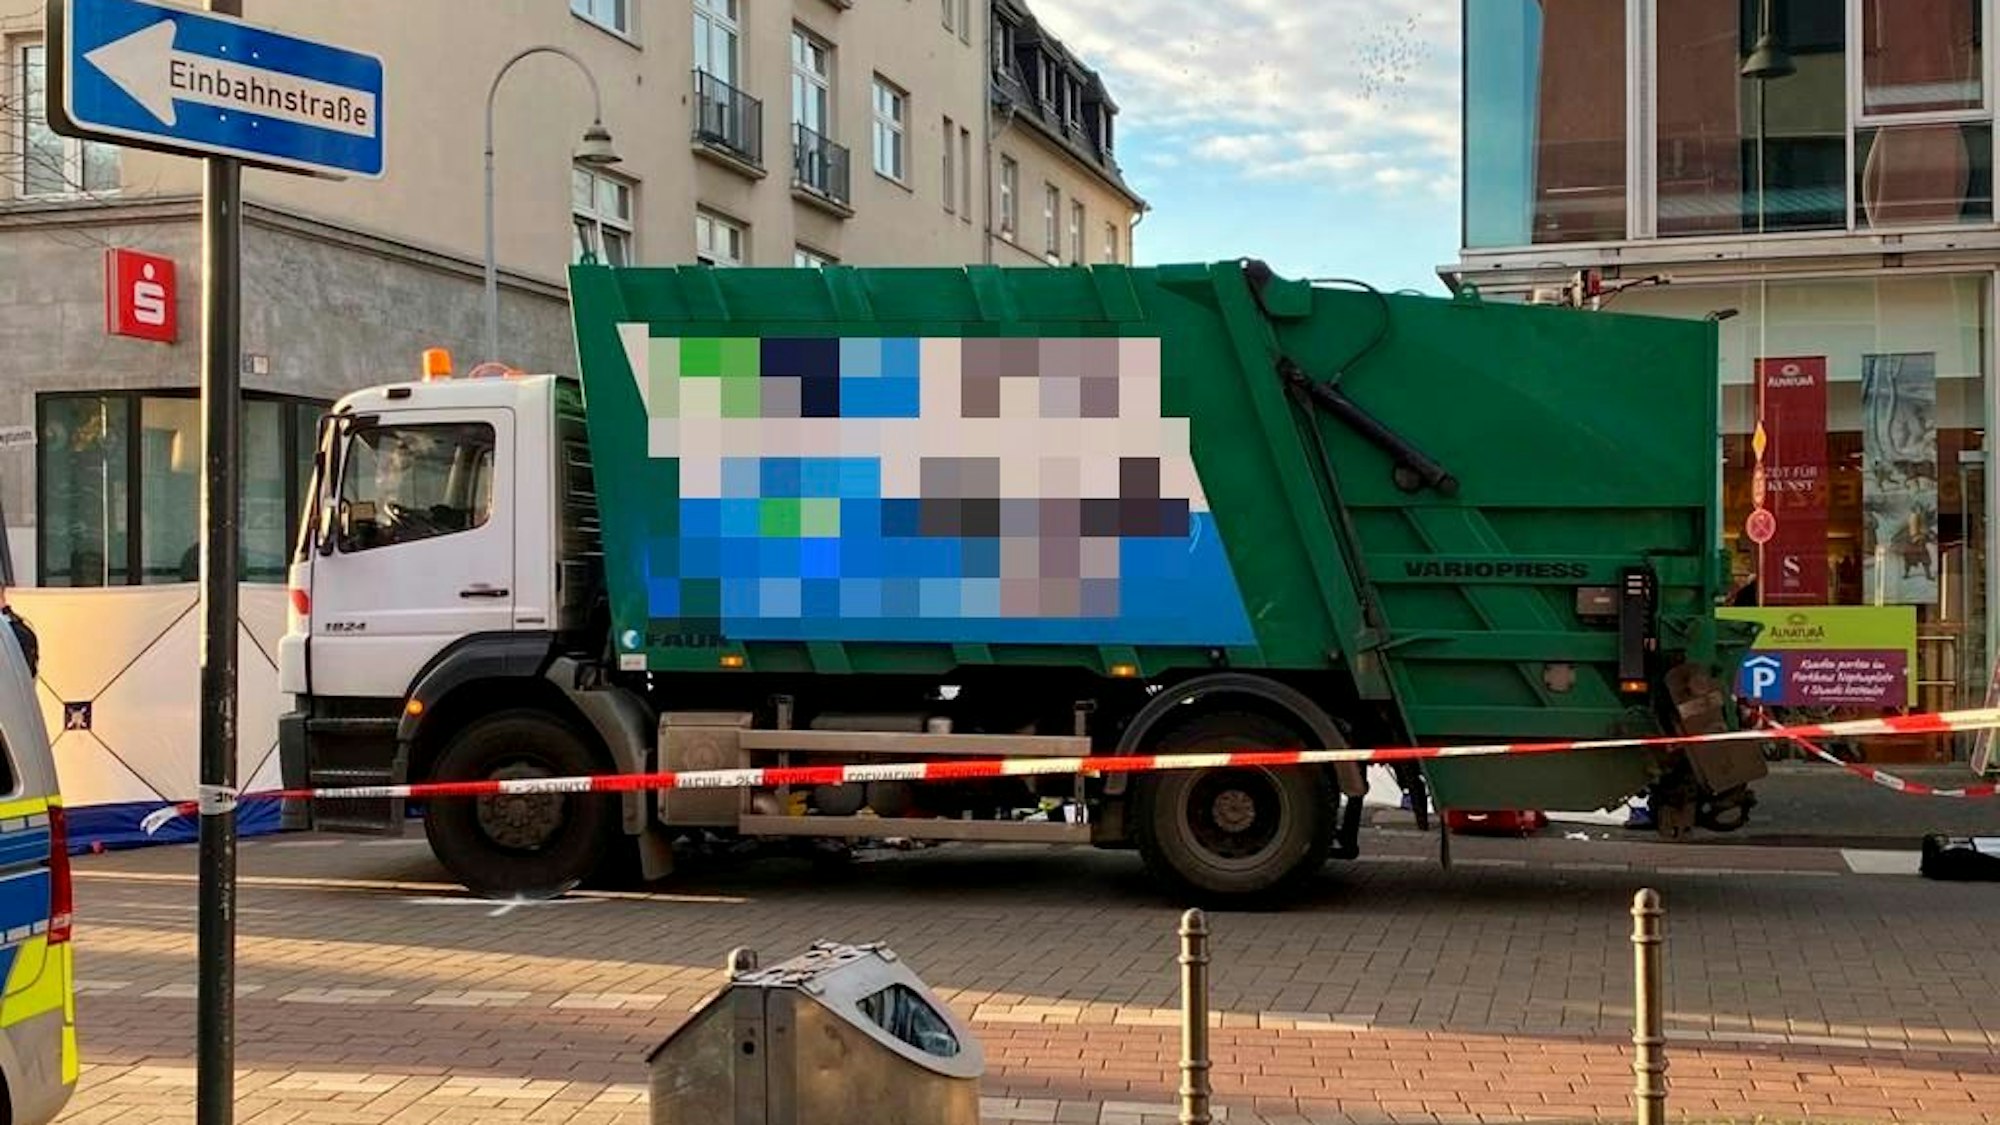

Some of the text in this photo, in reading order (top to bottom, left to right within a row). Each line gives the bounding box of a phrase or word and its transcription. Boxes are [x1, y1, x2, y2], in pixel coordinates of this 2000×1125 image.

[169, 59, 367, 126] Einbahnstraße
[1793, 465, 1818, 478] FÜR
[1767, 480, 1815, 492] KUNST
[1404, 561, 1590, 578] VARIOPRESS
[325, 622, 367, 632] 1824
[1752, 667, 1777, 698] P
